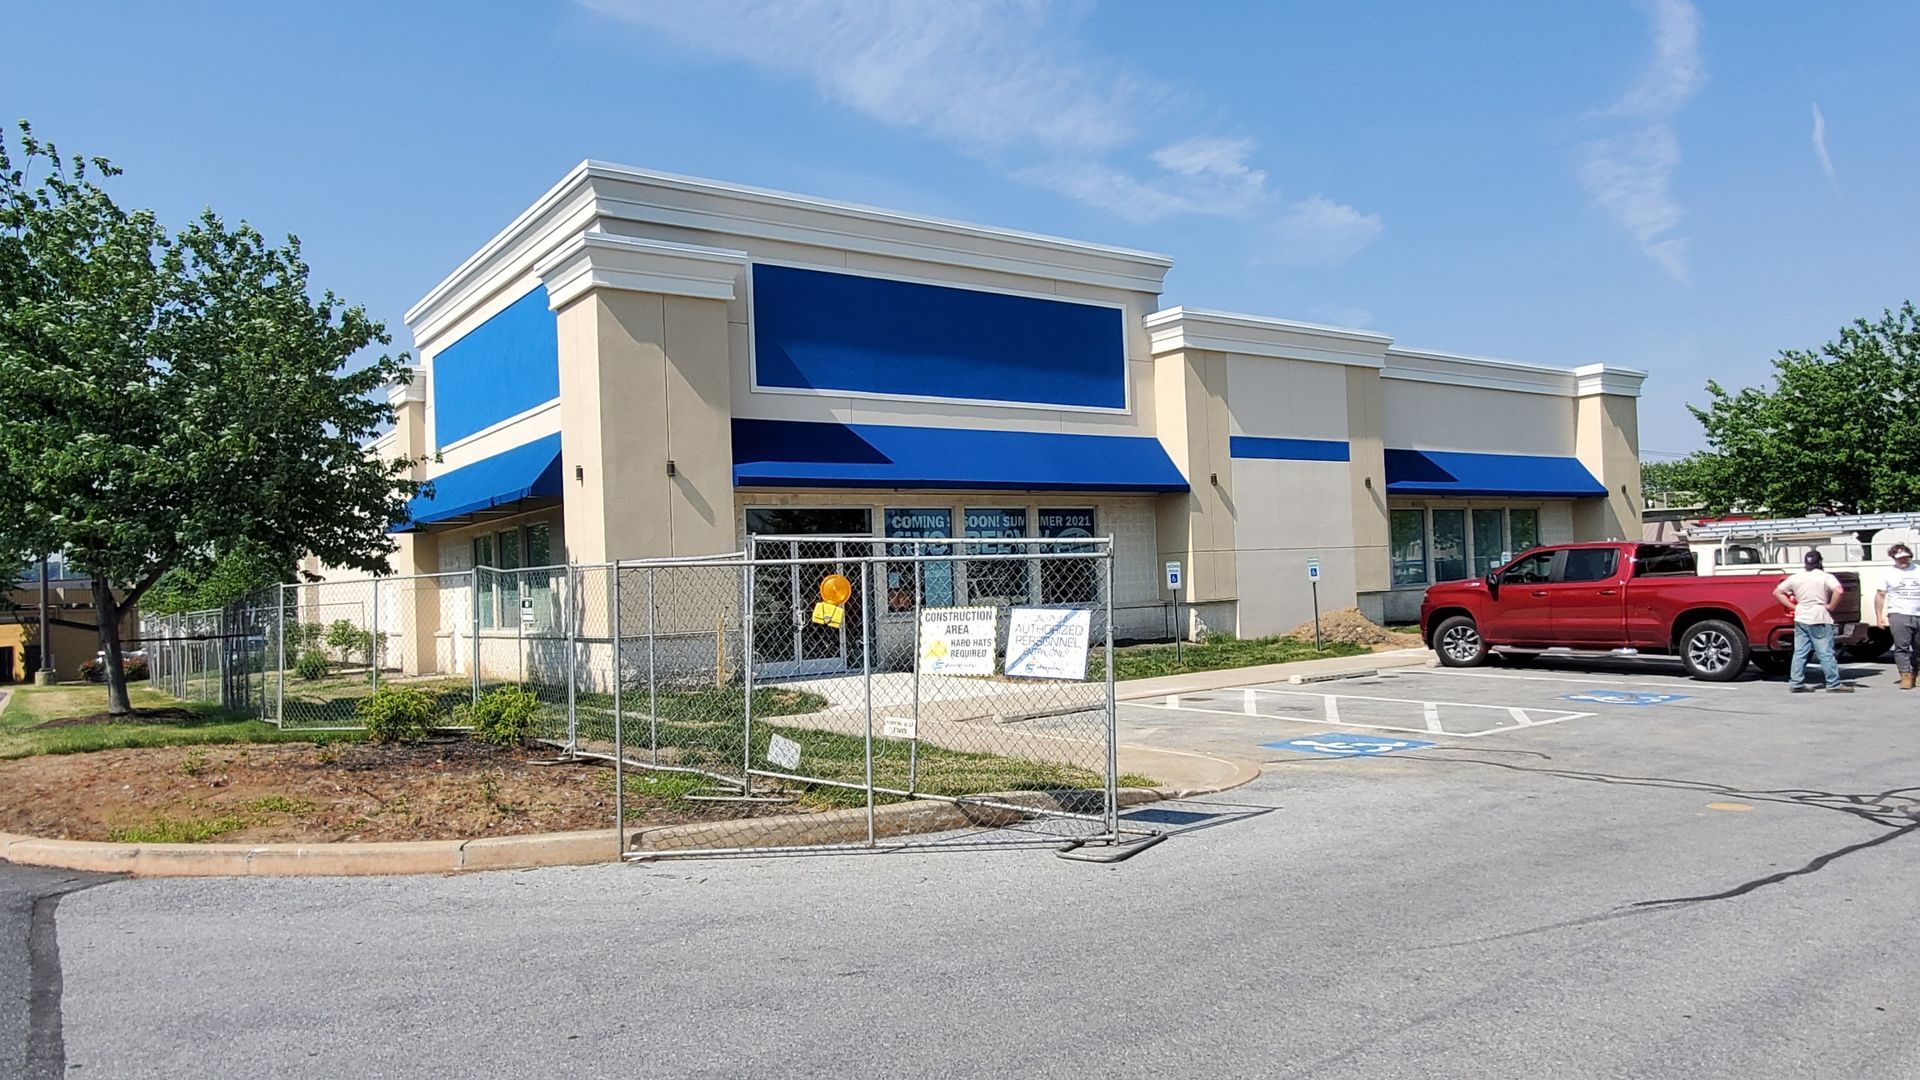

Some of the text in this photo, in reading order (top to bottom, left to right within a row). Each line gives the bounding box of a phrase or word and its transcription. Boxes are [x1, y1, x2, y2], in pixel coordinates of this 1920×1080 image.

[892, 515, 945, 528] COMING
[1065, 515, 1092, 527] 2021
[925, 610, 993, 623] CONSTRUCTION
[944, 624, 969, 636] AREA
[1014, 623, 1084, 637] AUTHORIZED
[950, 638, 992, 648] HARD HATS
[1015, 635, 1082, 650] PERSONNEL
[950, 649, 987, 658] REQUIRED
